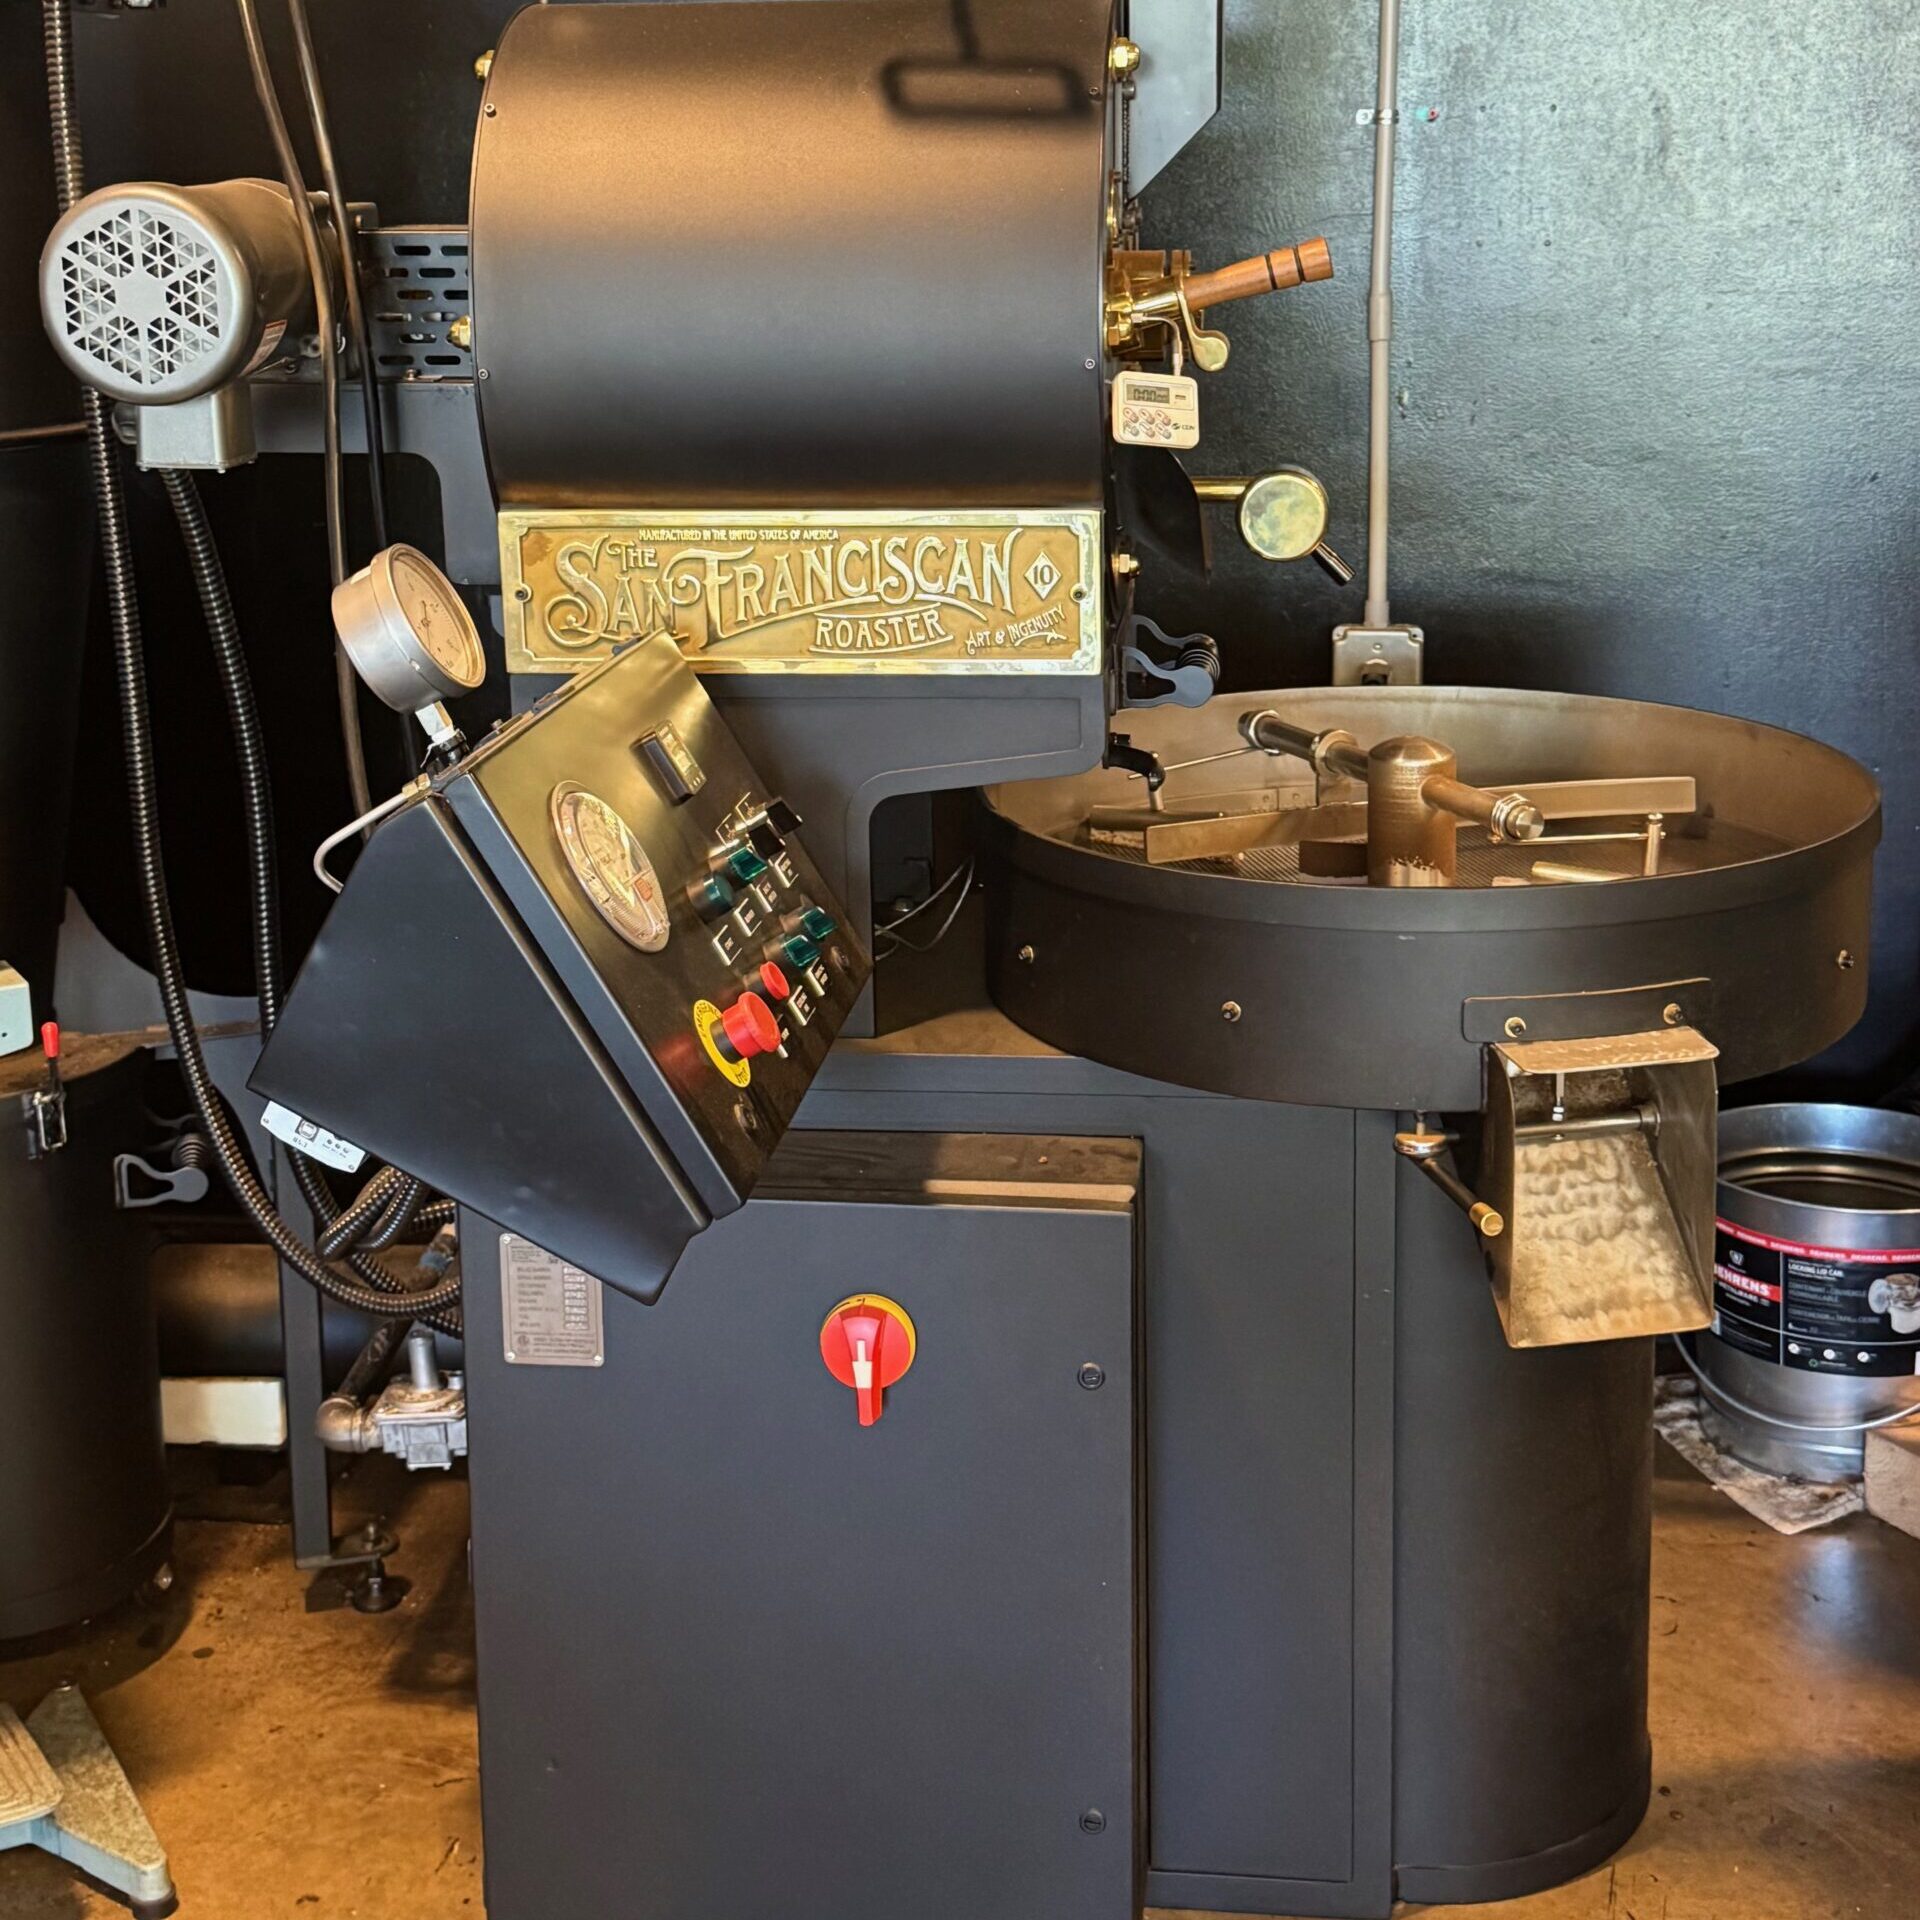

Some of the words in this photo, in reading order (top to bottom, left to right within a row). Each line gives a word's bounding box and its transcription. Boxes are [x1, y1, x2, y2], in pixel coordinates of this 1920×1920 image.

[639, 529, 701, 541] MANUFACTURED
[703, 530, 711, 540] IN
[712, 530, 728, 540] THE
[729, 530, 757, 540] UNITED
[759, 530, 788, 540] STATES
[790, 530, 800, 540] OF
[803, 530, 839, 541] AMERICA
[662, 527, 1024, 650] FRANCISCAN
[1032, 564, 1054, 586] 10
[815, 608, 947, 649] ROASTER
[965, 629, 992, 655] ART
[995, 630, 1006, 645] &
[1006, 603, 1066, 643] INGENUITY
